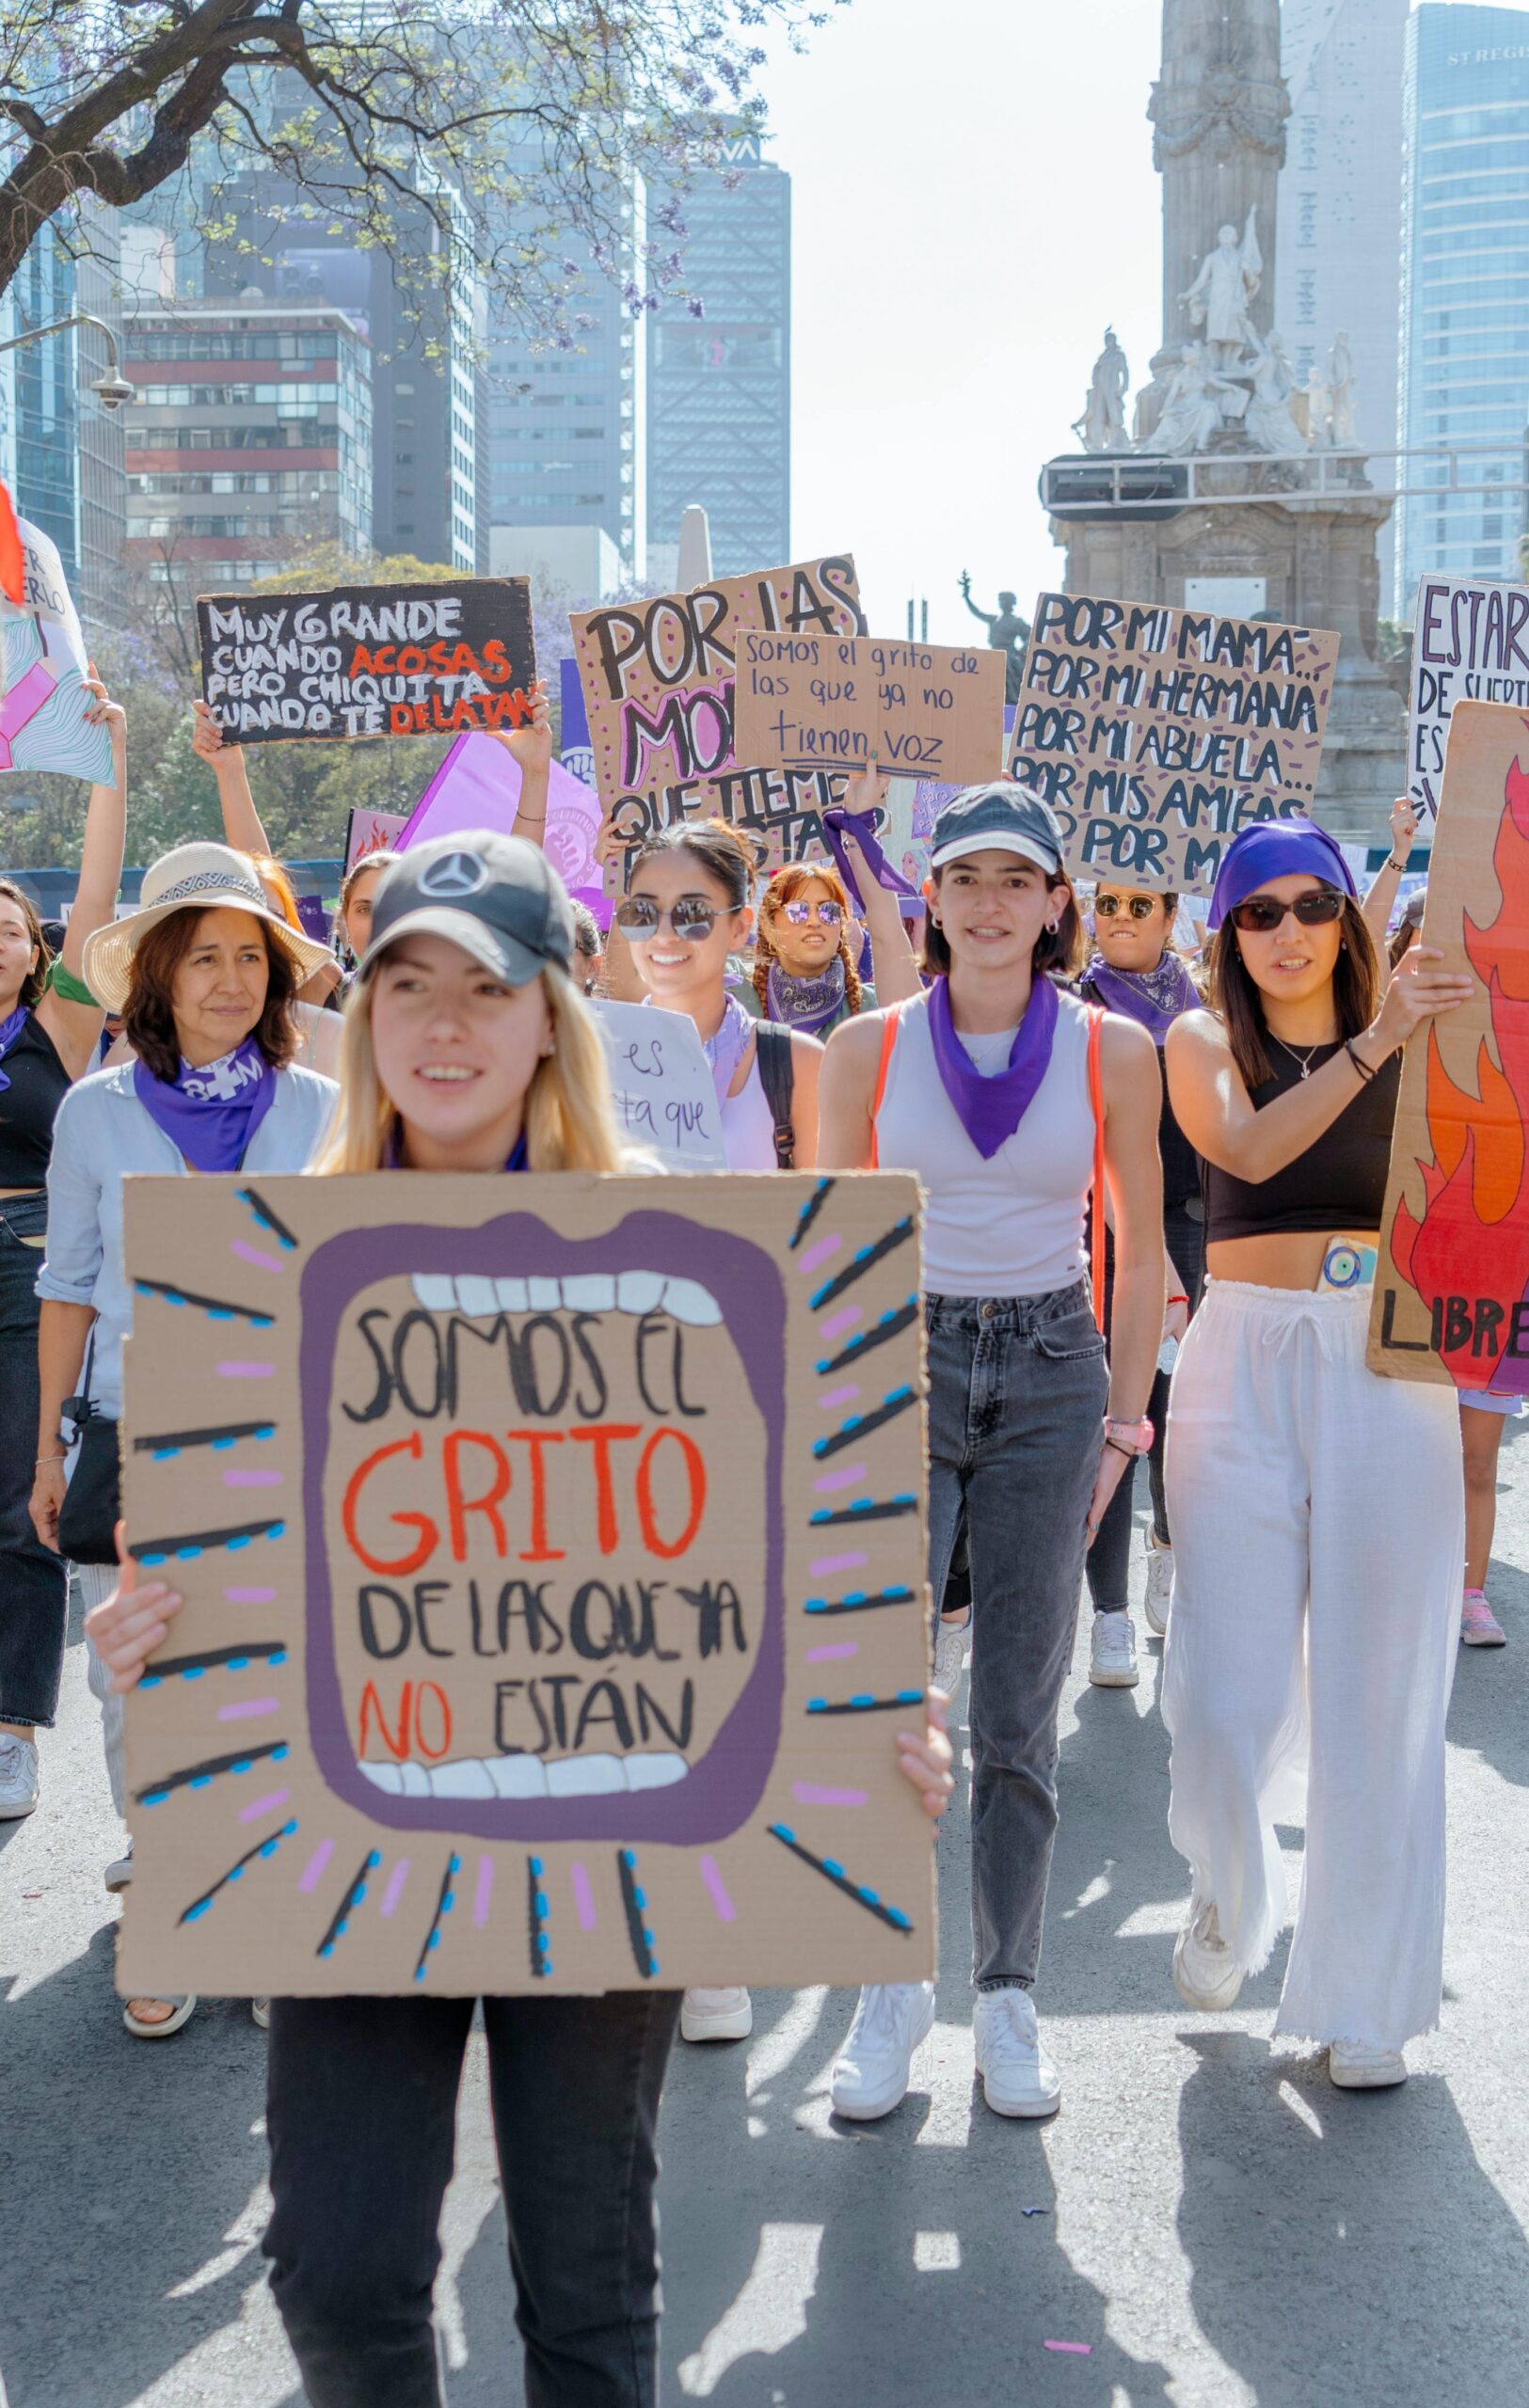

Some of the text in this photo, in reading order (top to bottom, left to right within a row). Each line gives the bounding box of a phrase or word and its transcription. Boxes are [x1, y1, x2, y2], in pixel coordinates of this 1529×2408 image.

[1474, 44, 1529, 63] REGI
[294, 597, 462, 643] GRANDE
[586, 591, 736, 702] POR
[1035, 594, 1124, 649] POR
[1125, 608, 1172, 654] MI
[1422, 584, 1529, 671] ESTAR
[208, 670, 492, 706] PERO CHIQUITA
[212, 639, 512, 684] CUANDO ACOSAS
[837, 641, 856, 665] el
[871, 644, 932, 676] grito
[951, 653, 980, 674] de
[209, 696, 331, 732] CUANDO
[340, 704, 386, 737] TE
[753, 668, 953, 710] las que ya no
[1027, 649, 1318, 734] POR MI HERMANA
[1417, 667, 1454, 719] DE
[621, 674, 736, 790] MO
[770, 709, 868, 756] tienen
[1017, 704, 1079, 755] POR
[1089, 715, 1134, 762] MI
[1011, 756, 1075, 806] POR
[1084, 770, 1149, 821] MIS
[1081, 818, 1168, 876] POR
[1183, 837, 1231, 884] M
[665, 1101, 709, 1148] que
[1381, 1290, 1529, 1358] LIBRE
[342, 1309, 707, 1423] SOMOS EL
[342, 1424, 708, 1576] GRITO
[358, 1579, 747, 1660] DE LAS QUE YA
[358, 1666, 693, 1760] NO ESTÁN
